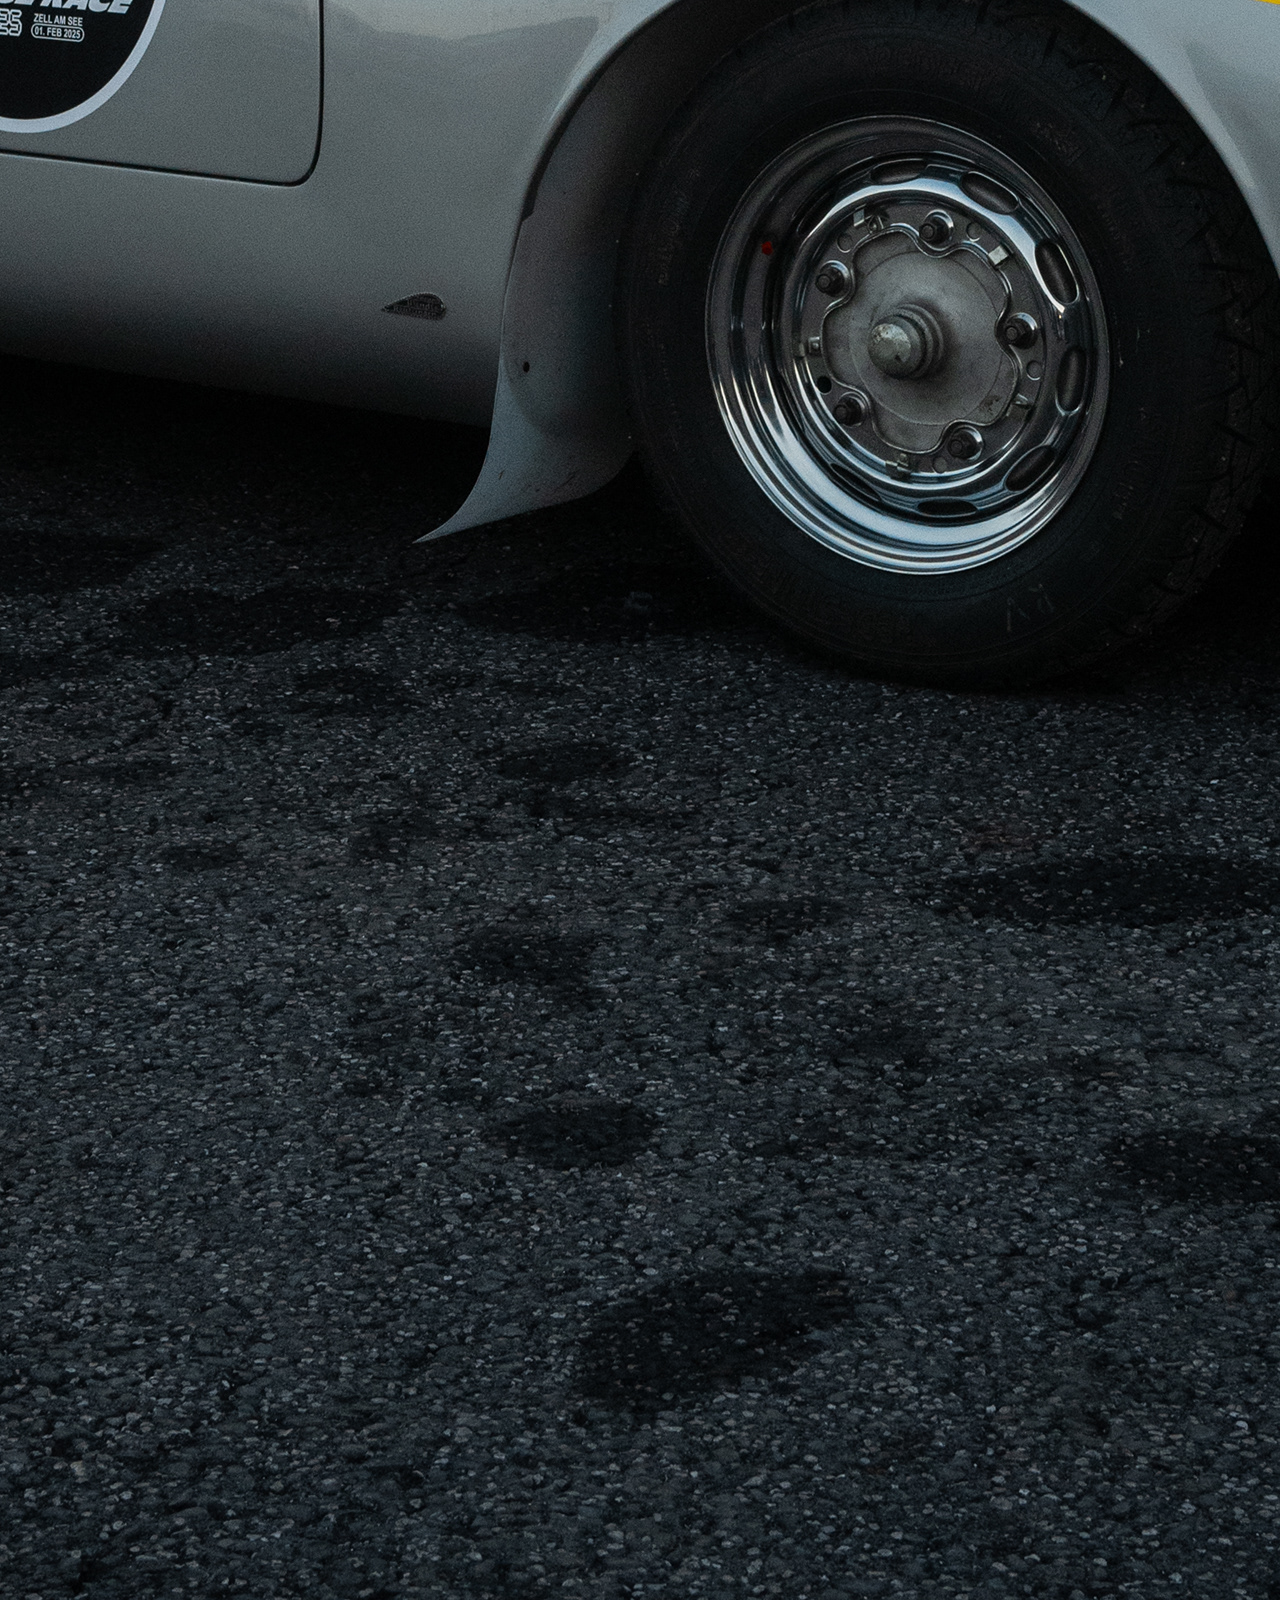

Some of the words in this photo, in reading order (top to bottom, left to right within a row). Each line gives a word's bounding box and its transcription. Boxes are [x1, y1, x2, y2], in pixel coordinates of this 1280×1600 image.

[33, 13, 53, 24] ZELL
[54, 15, 66, 25] AM
[67, 16, 83, 27] SEE
[34, 26, 45, 36] 01.
[47, 27, 62, 37] FEB
[63, 28, 81, 39] 2025
